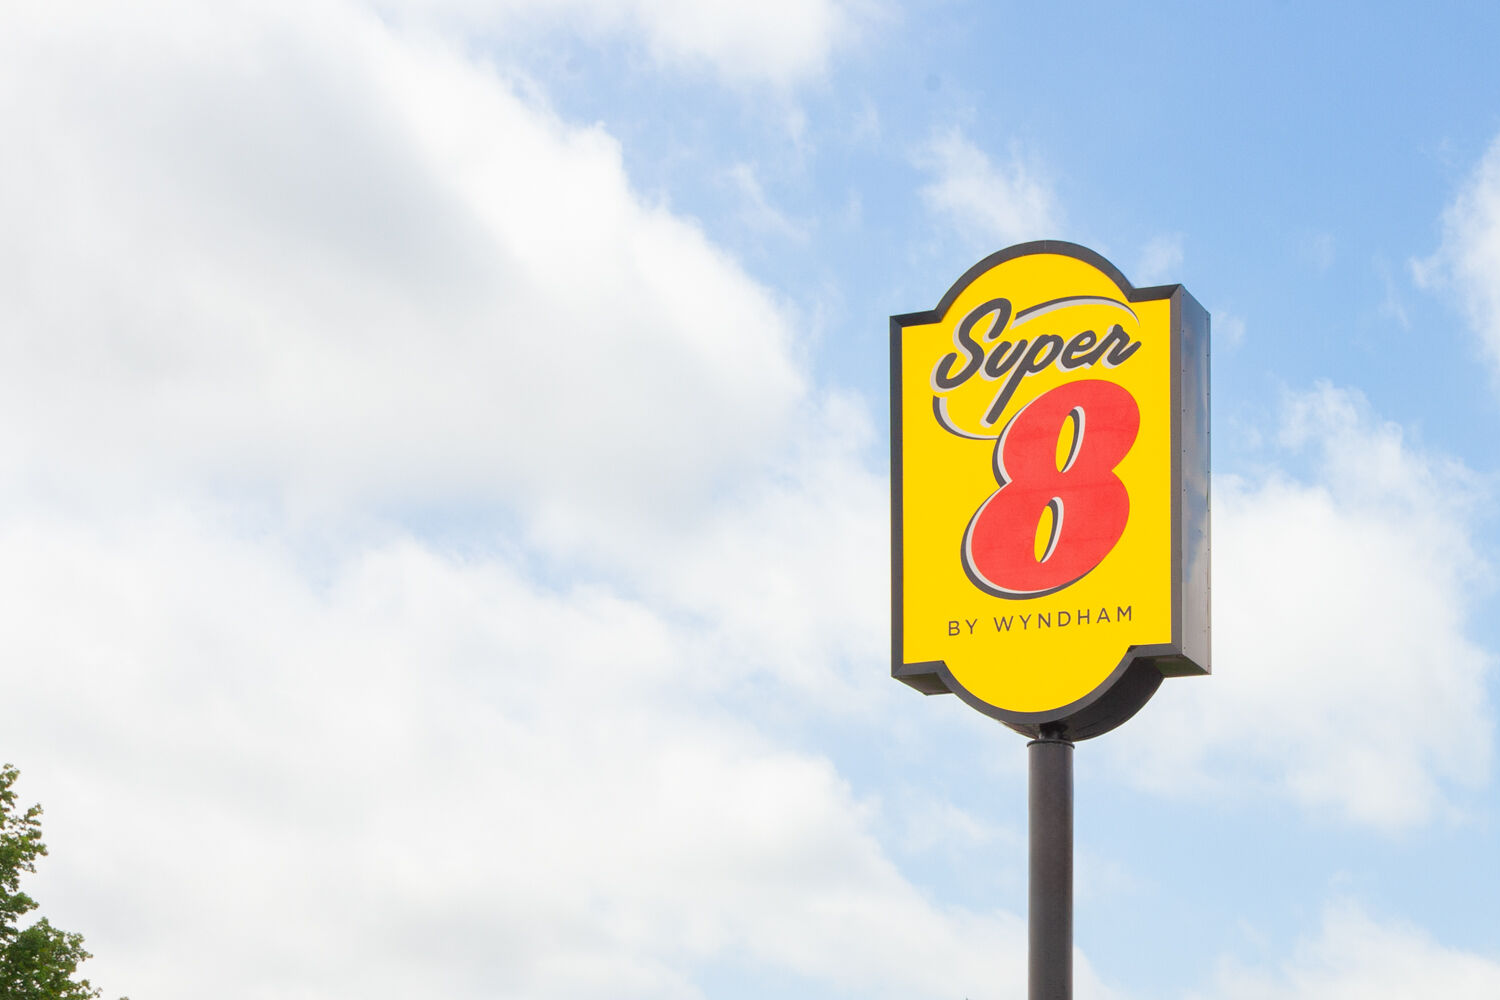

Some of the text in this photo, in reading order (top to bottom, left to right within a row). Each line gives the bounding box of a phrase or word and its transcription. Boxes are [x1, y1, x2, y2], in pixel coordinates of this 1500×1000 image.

[931, 297, 1142, 428] Super
[960, 379, 1140, 600] 8
[948, 605, 1132, 636] BY WYNDHAM
